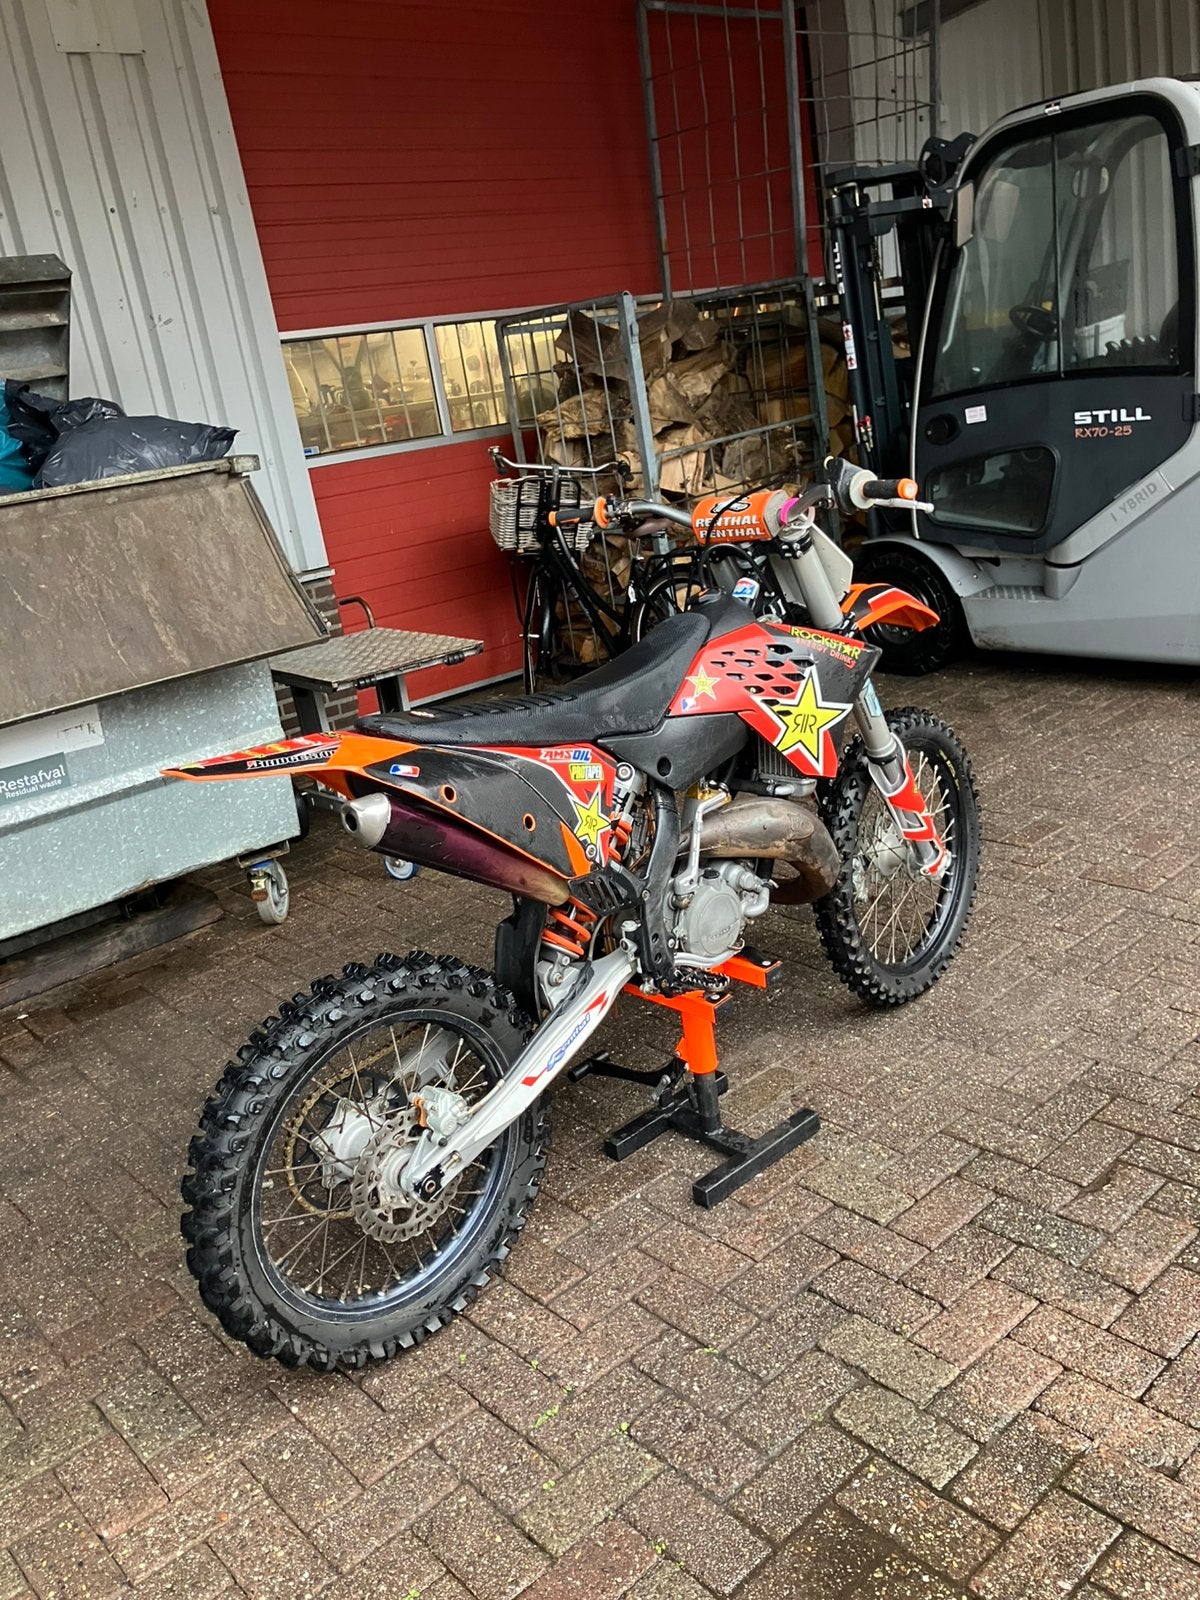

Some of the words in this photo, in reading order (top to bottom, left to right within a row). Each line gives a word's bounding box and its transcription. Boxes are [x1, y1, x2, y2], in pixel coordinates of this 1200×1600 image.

[833, 242, 846, 294] STILL
[1074, 407, 1152, 425] STILL
[1074, 425, 1133, 438] RX70-25
[695, 515, 760, 528] RENTHAL
[700, 527, 765, 539] RENTHAL
[543, 749, 590, 761] AMSOIL
[0, 764, 66, 794] Restafval
[6, 785, 39, 799] Residual
[40, 779, 62, 789] waste
